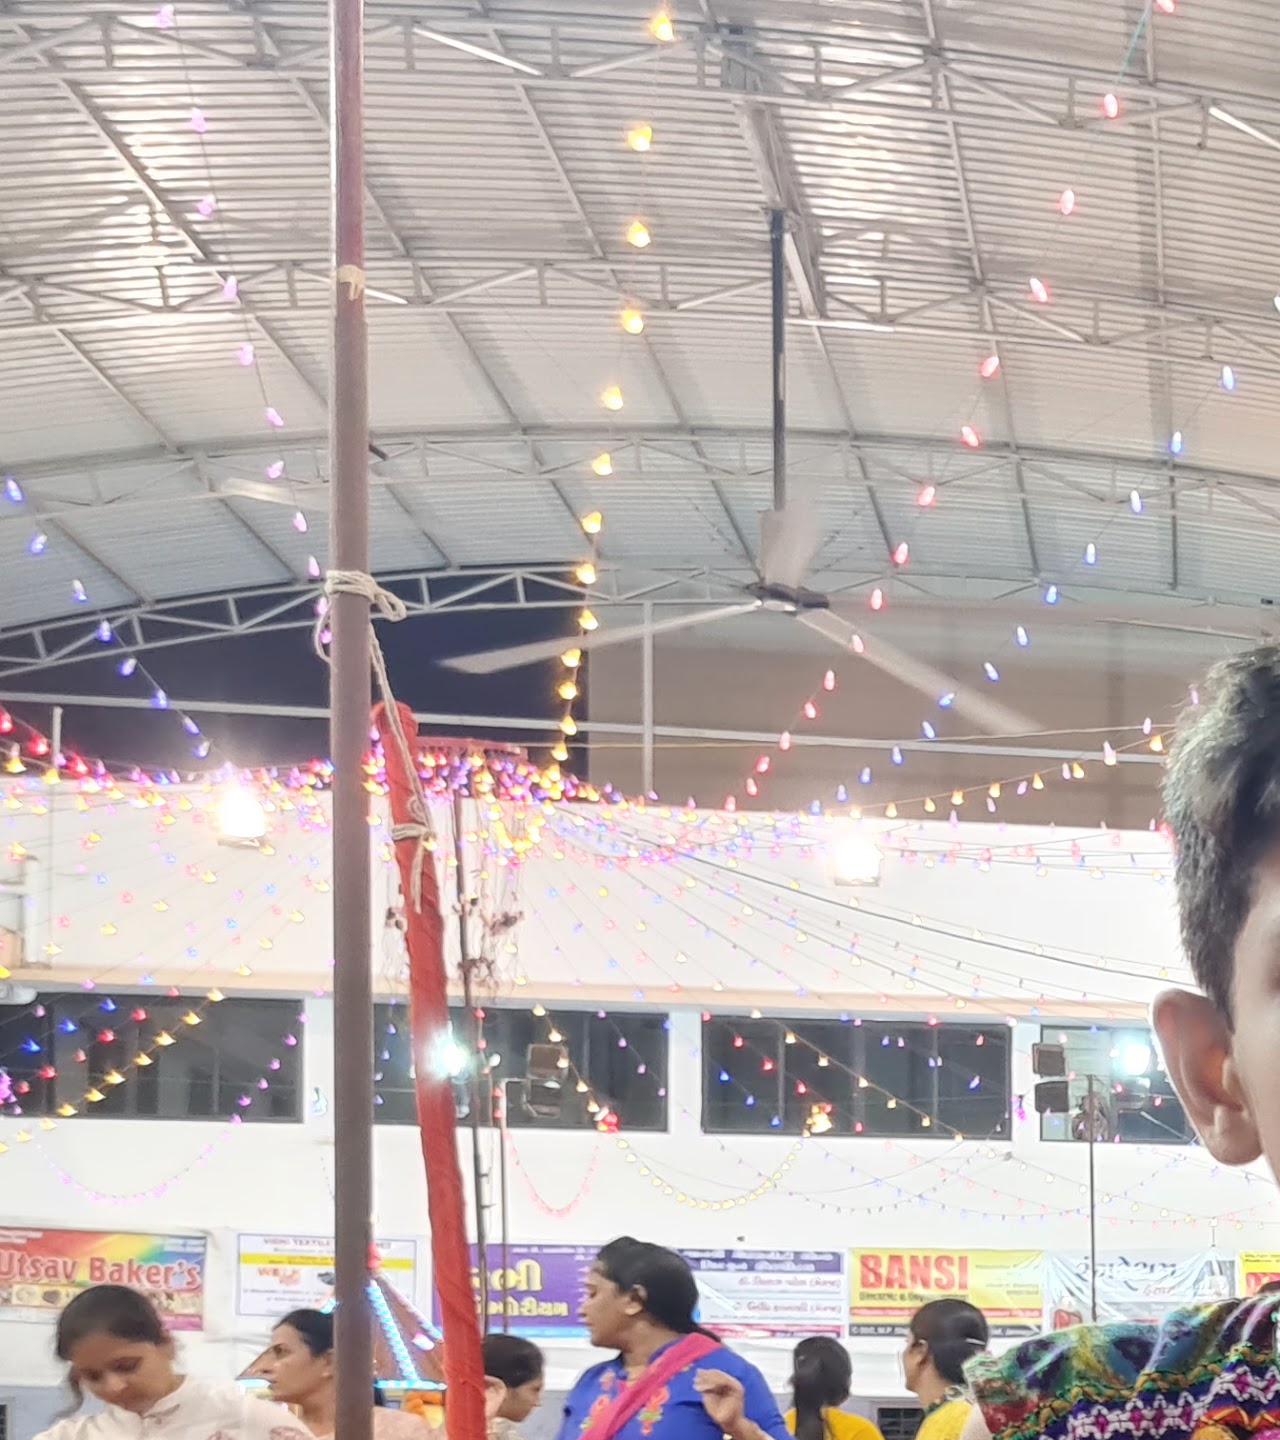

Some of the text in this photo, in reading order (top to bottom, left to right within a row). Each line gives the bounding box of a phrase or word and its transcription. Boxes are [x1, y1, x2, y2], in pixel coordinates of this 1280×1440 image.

[0, 1250, 202, 1289] Utsav Baker's
[859, 1253, 970, 1291] BANSI
